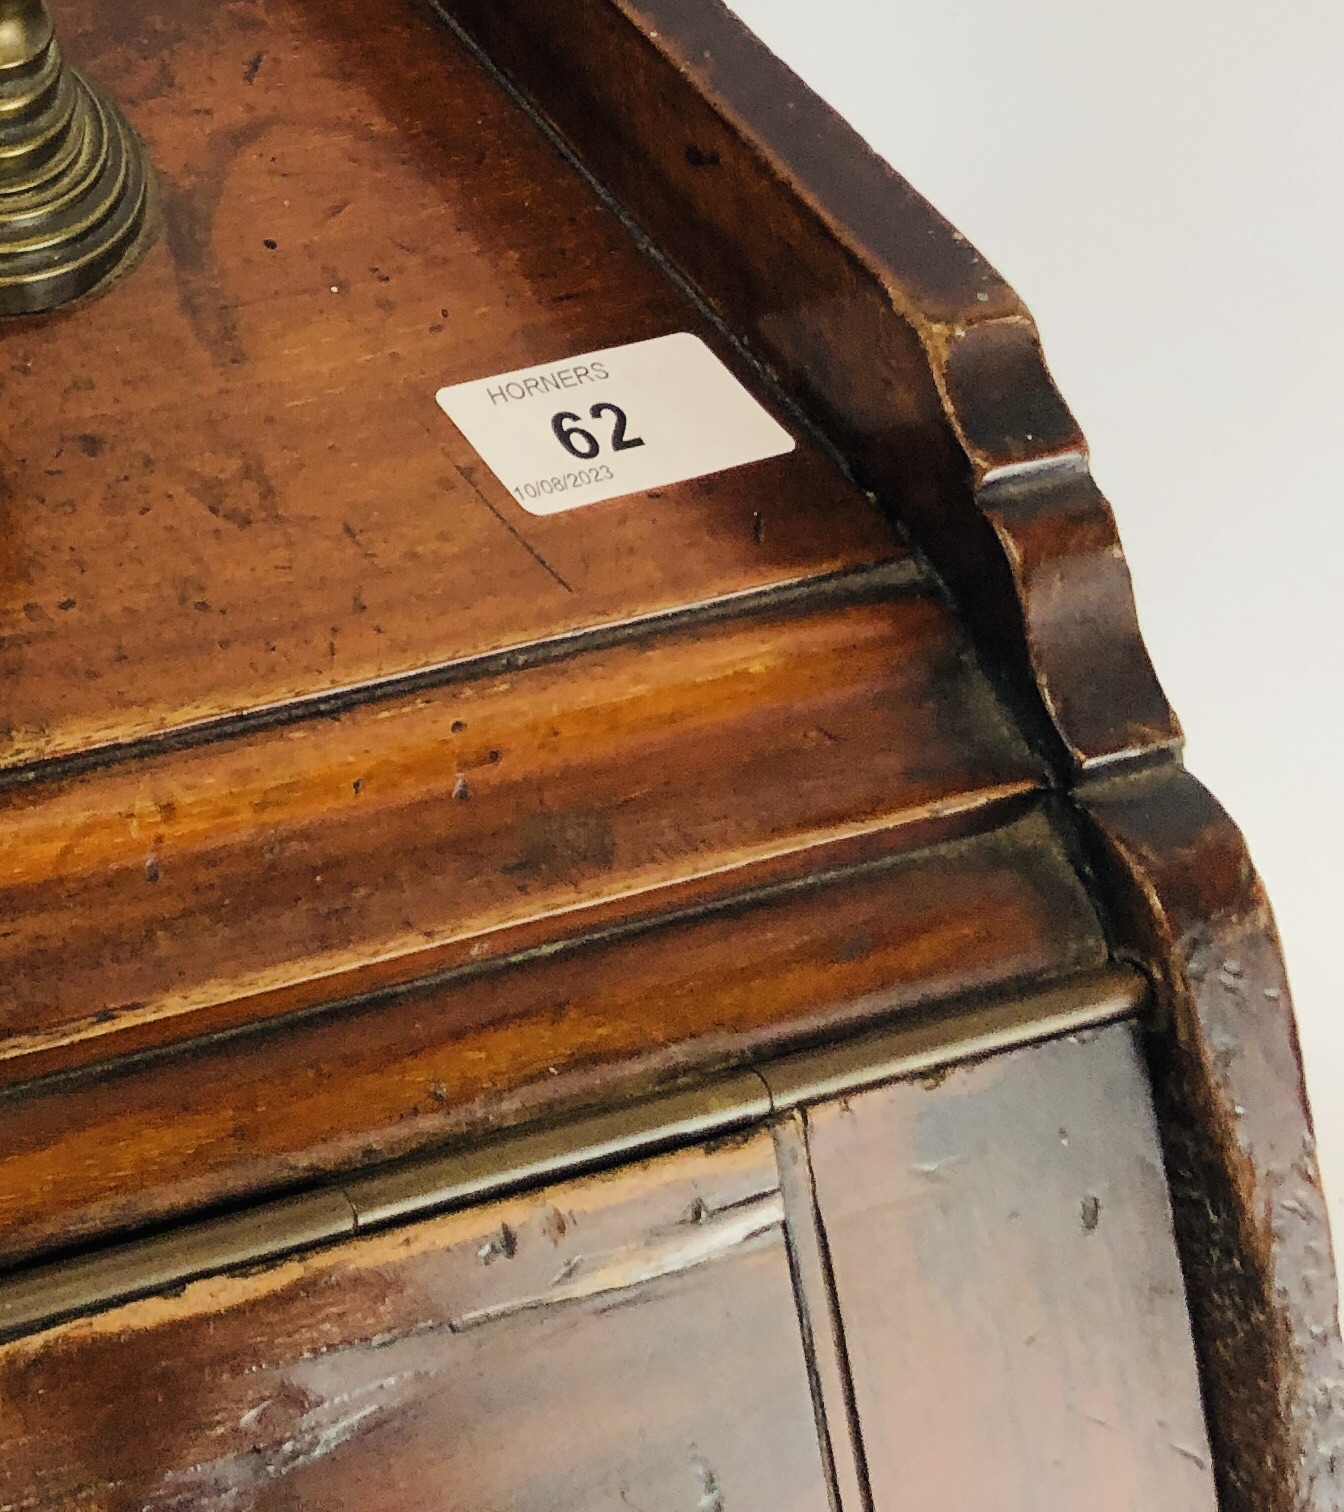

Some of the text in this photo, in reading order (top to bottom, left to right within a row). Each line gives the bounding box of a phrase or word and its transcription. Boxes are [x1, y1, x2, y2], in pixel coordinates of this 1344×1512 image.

[486, 362, 610, 406] HORNERS
[551, 402, 645, 459] 62
[513, 465, 614, 501] 10/08/2023
